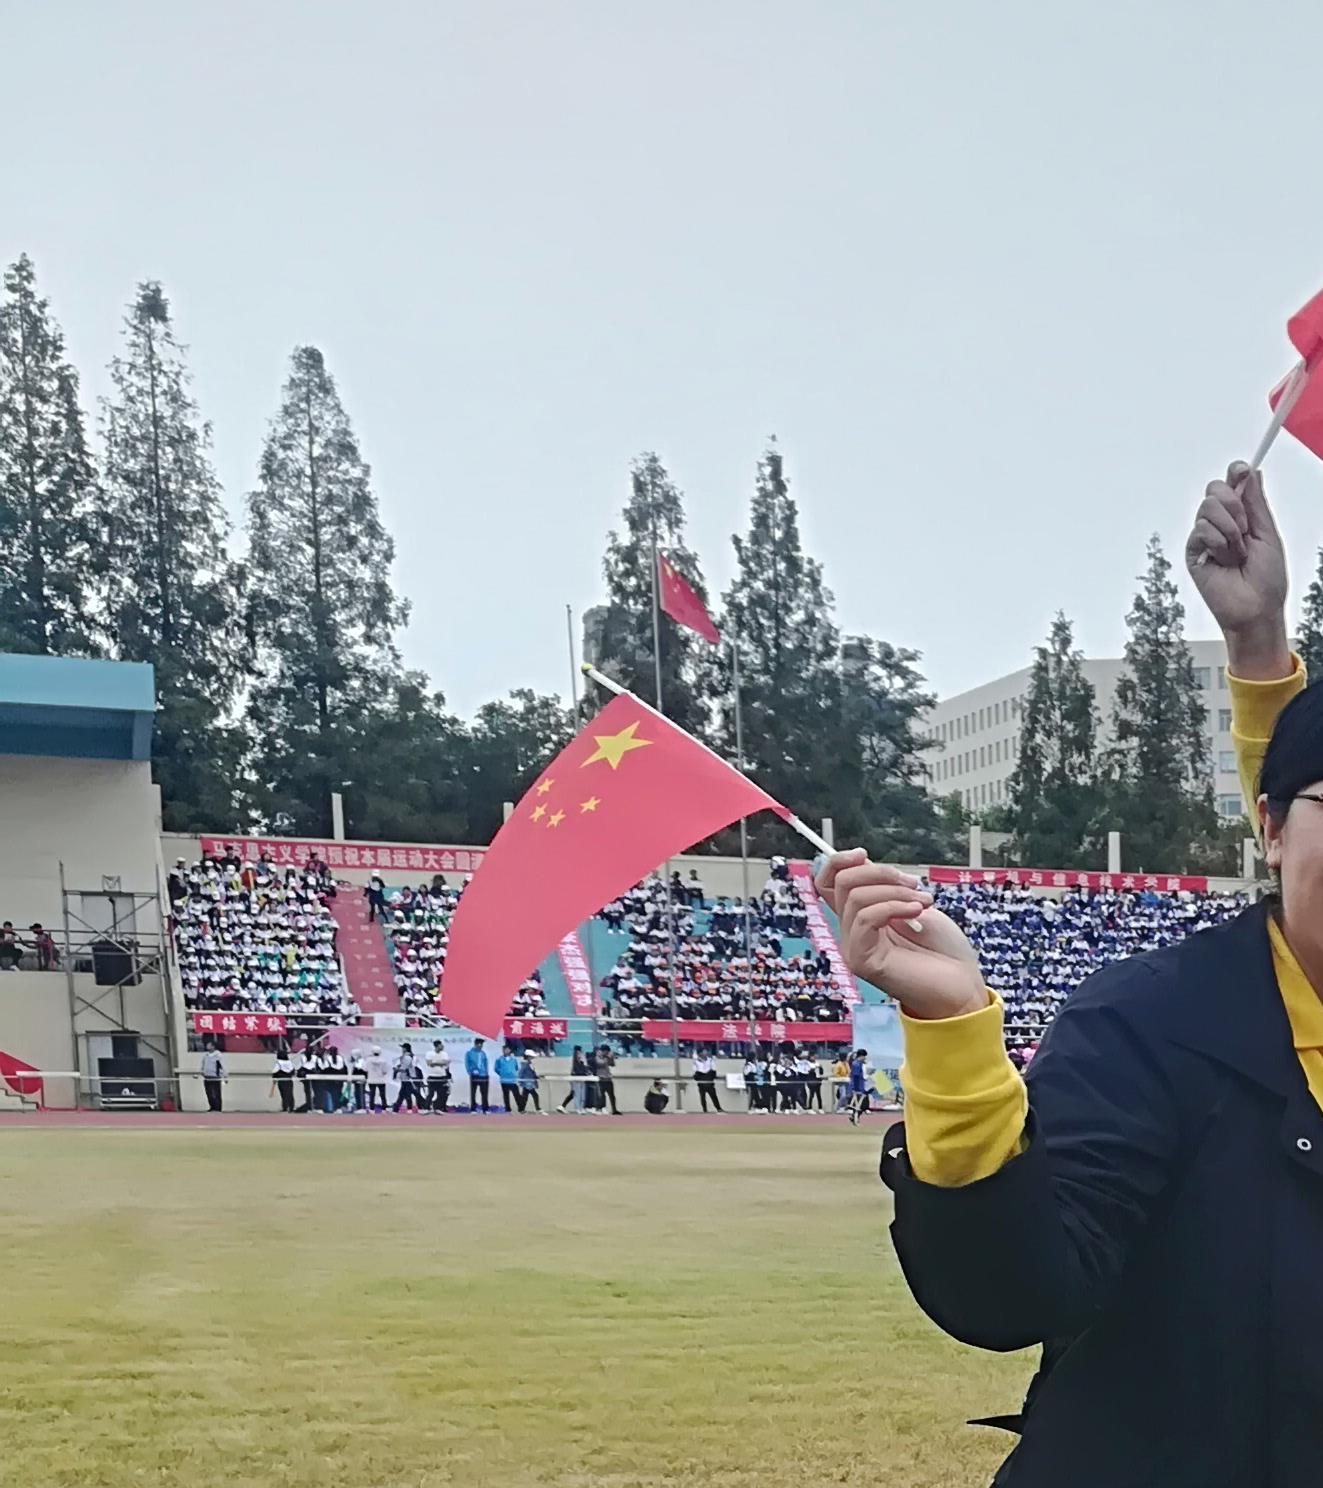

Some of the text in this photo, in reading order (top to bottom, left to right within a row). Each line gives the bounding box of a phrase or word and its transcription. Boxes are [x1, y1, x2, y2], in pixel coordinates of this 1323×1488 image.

[958, 871, 1181, 891] 计算机与信息技术学院
[200, 1015, 283, 1031] 团结紧张
[722, 1023, 787, 1039] 法学院
